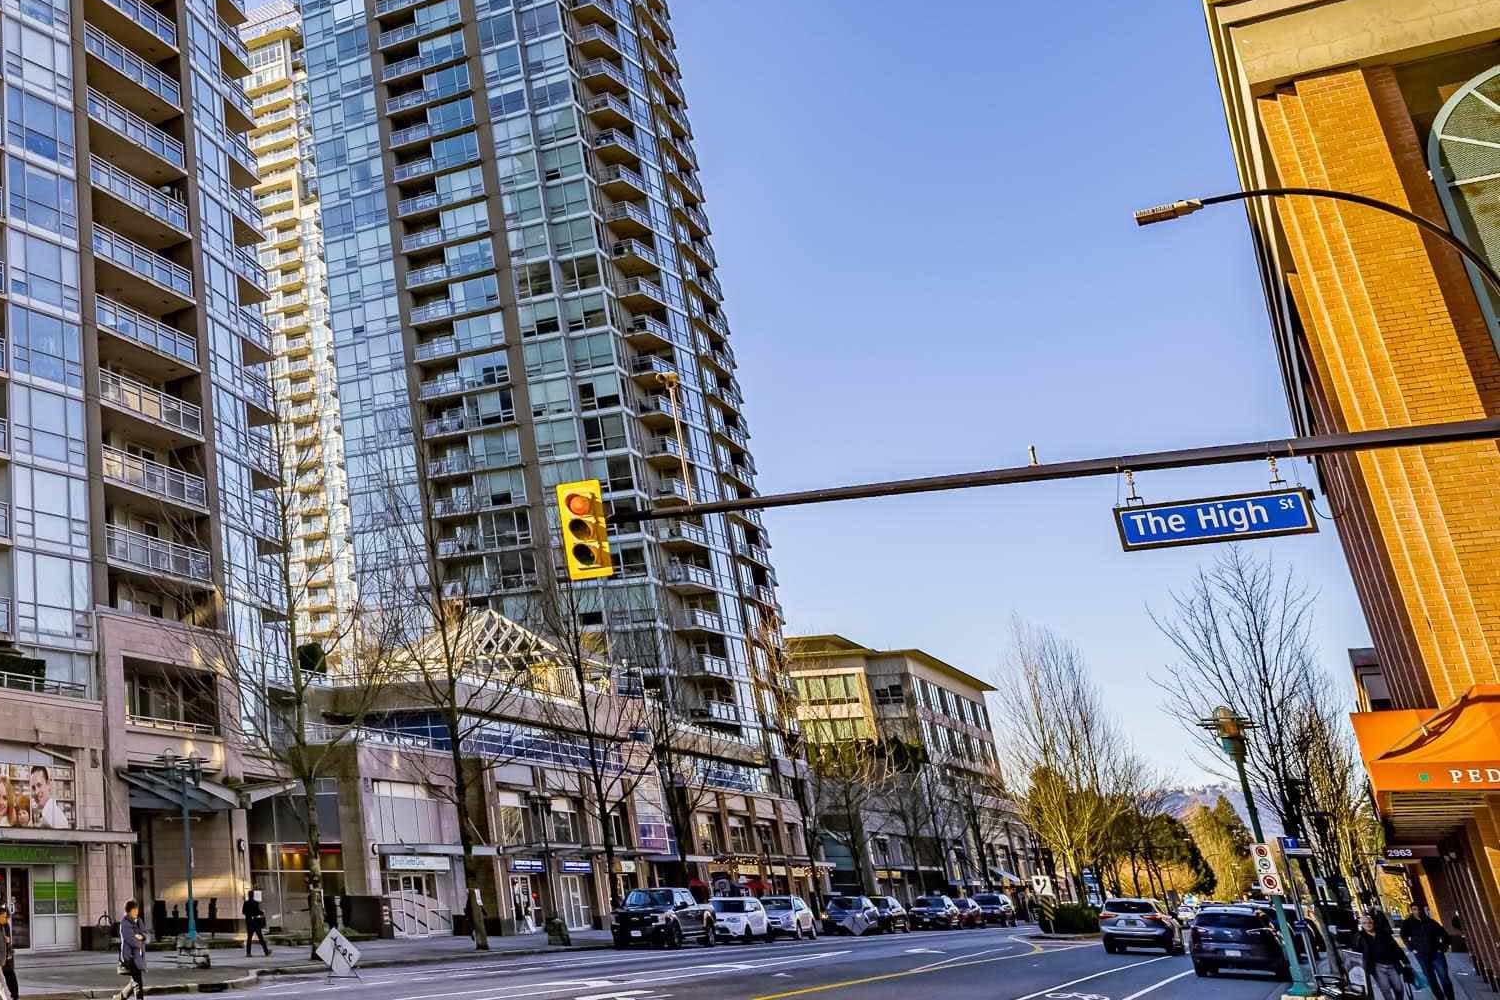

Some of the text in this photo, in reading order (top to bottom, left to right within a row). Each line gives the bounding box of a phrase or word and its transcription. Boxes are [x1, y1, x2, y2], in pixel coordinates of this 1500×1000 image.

[1130, 498, 1295, 536] The High St
[1448, 768, 1500, 784] PED
